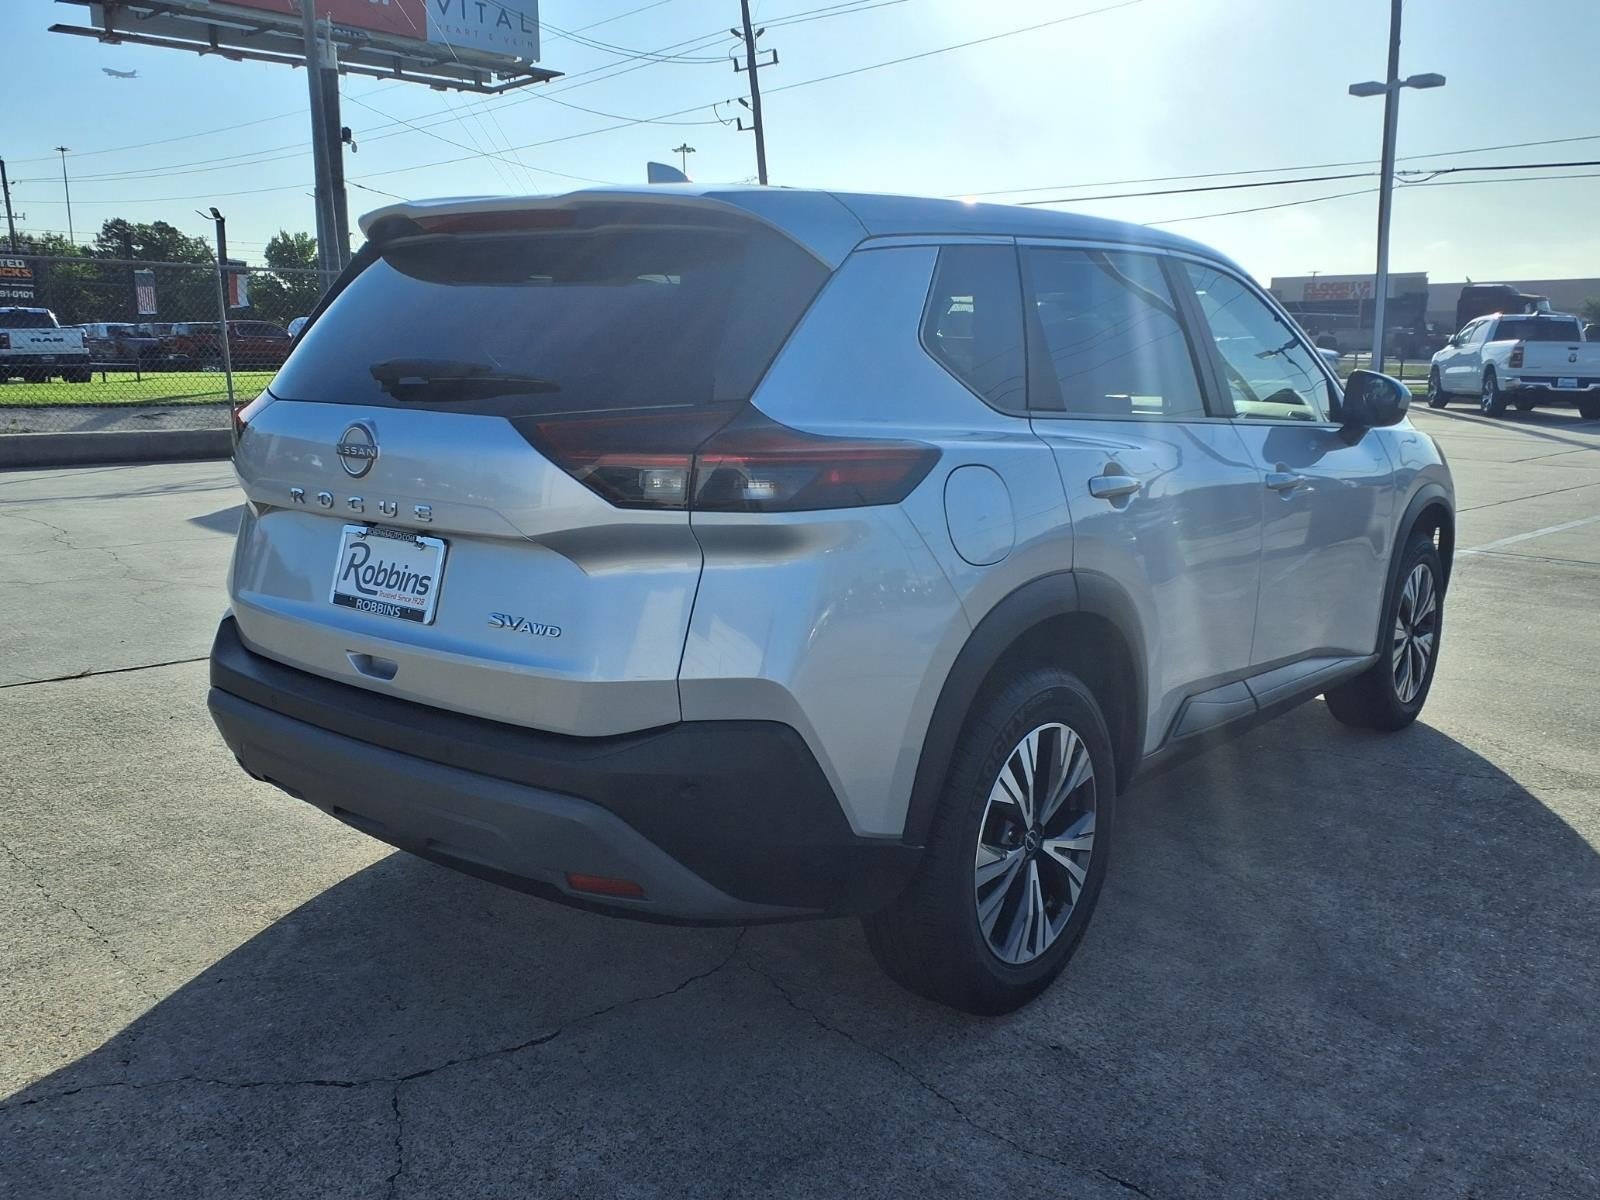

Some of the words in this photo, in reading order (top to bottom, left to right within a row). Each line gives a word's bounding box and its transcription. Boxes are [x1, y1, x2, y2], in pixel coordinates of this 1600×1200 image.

[437, 0, 532, 33] VITAL
[0, 267, 33, 278] CKS
[338, 445, 375, 457] NSSAN
[289, 487, 433, 523] ROGUE
[342, 541, 432, 596] Robbins
[355, 598, 401, 617] ROBBINS
